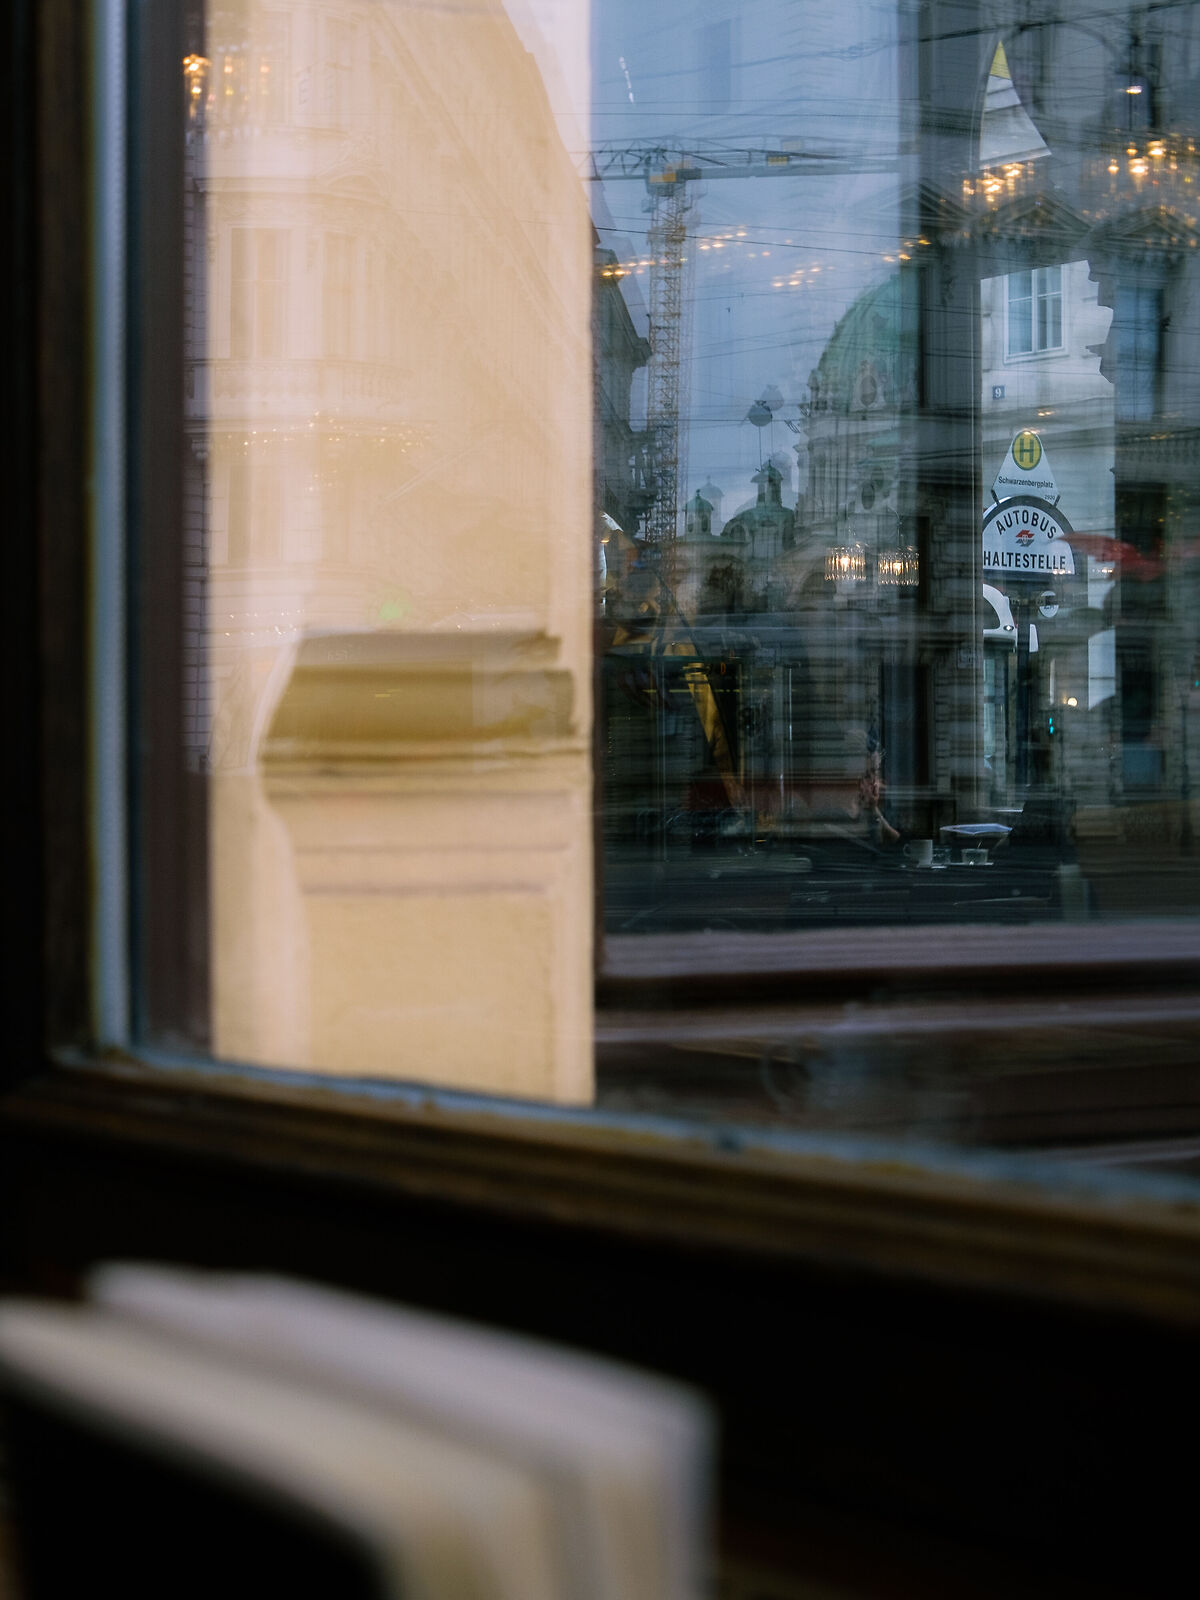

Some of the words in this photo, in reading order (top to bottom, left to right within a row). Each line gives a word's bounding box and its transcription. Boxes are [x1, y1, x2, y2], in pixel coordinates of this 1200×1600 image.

[995, 387, 1001, 398] 9
[1019, 438, 1034, 463] H
[998, 475, 1054, 489] Schwarzenbergplatz
[996, 509, 1057, 540] AUTOBUS
[983, 550, 1066, 570] HALTESTELLE
